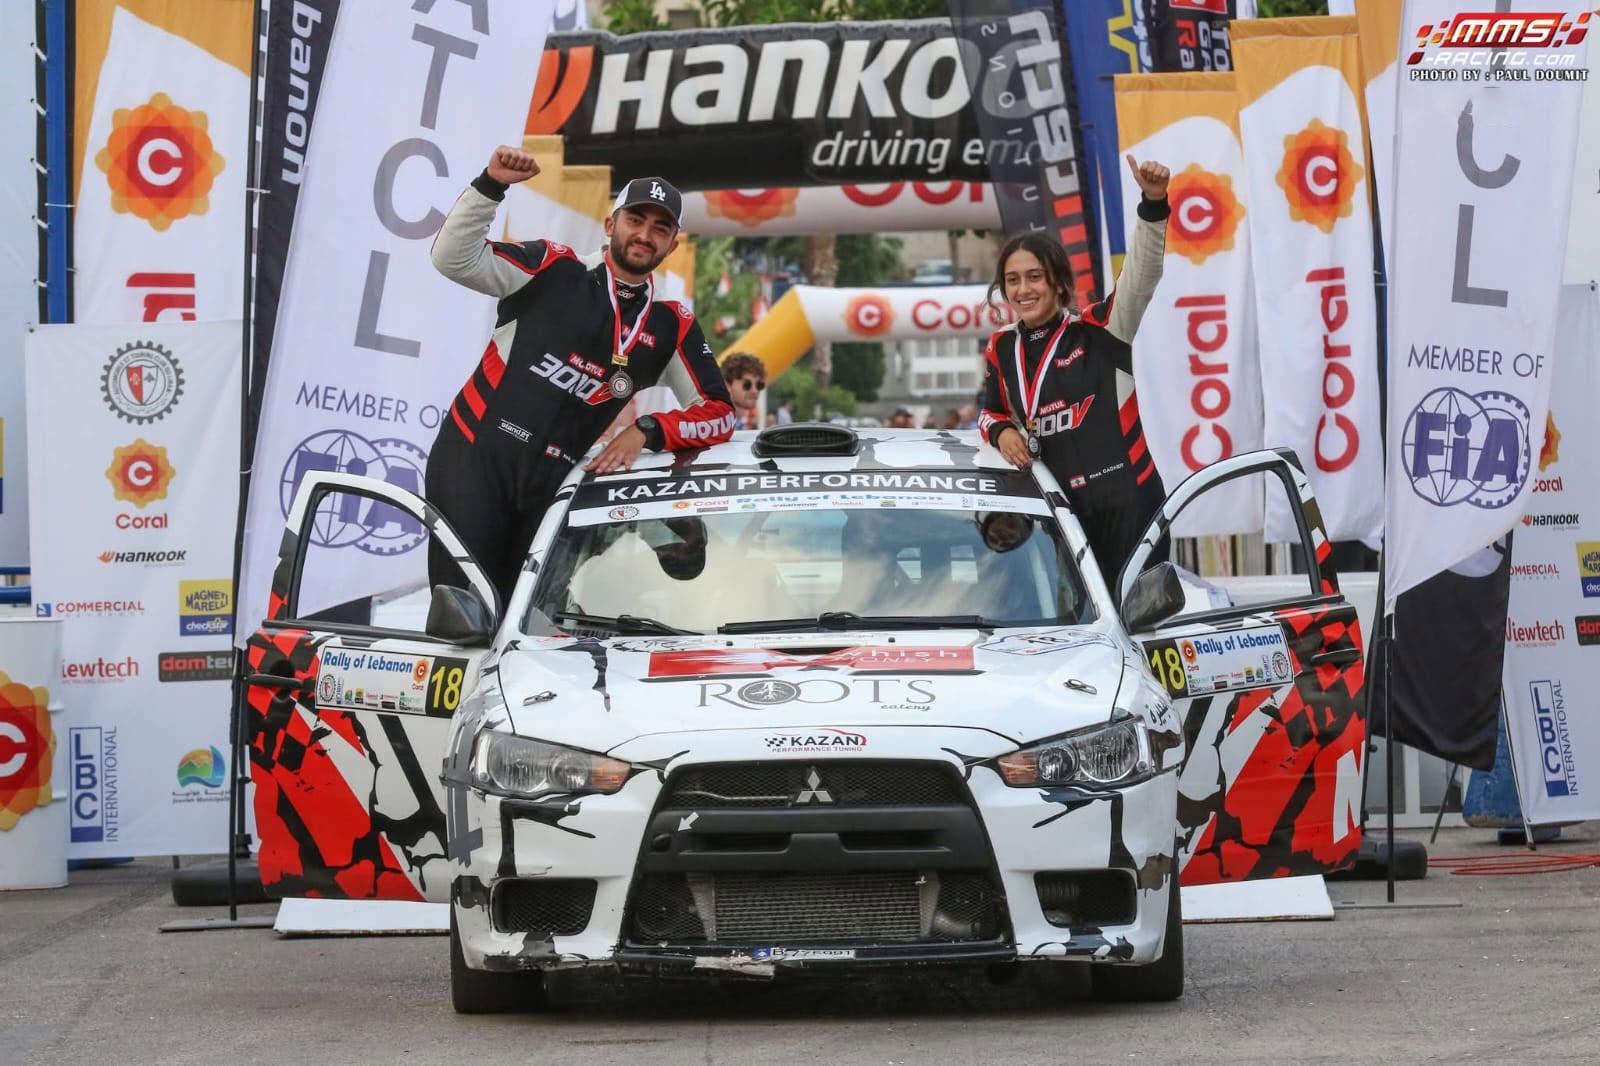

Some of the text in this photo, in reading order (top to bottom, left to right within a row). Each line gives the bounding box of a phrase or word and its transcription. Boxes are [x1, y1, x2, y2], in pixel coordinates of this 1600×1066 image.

[811, 130, 949, 175] driving
[650, 181, 666, 201] LA
[911, 299, 1018, 331] Cora
[622, 326, 655, 345] MTUL
[1057, 348, 1084, 368] MOTUL
[1306, 266, 1360, 473] Coral
[1407, 343, 1545, 379] MEMBER OF
[1174, 294, 1233, 474] Coral
[296, 381, 409, 423] MEMBER
[607, 473, 998, 502] KAZAN PERFORMANCE
[115, 513, 168, 529] Coral
[56, 600, 145, 614] COMMERCIAL
[1194, 632, 1282, 655] Rally of Lebanon
[161, 655, 233, 672] damte
[323, 651, 414, 673] Rally of Lebanon
[1151, 647, 1185, 690] 18
[431, 665, 463, 711] 18
[696, 679, 937, 711] ROOTS
[881, 703, 933, 712] eatery
[790, 735, 859, 747] KAZAN
[1552, 679, 1579, 797] INTERNATIONAL
[104, 725, 119, 843] INTERNATIONAL
